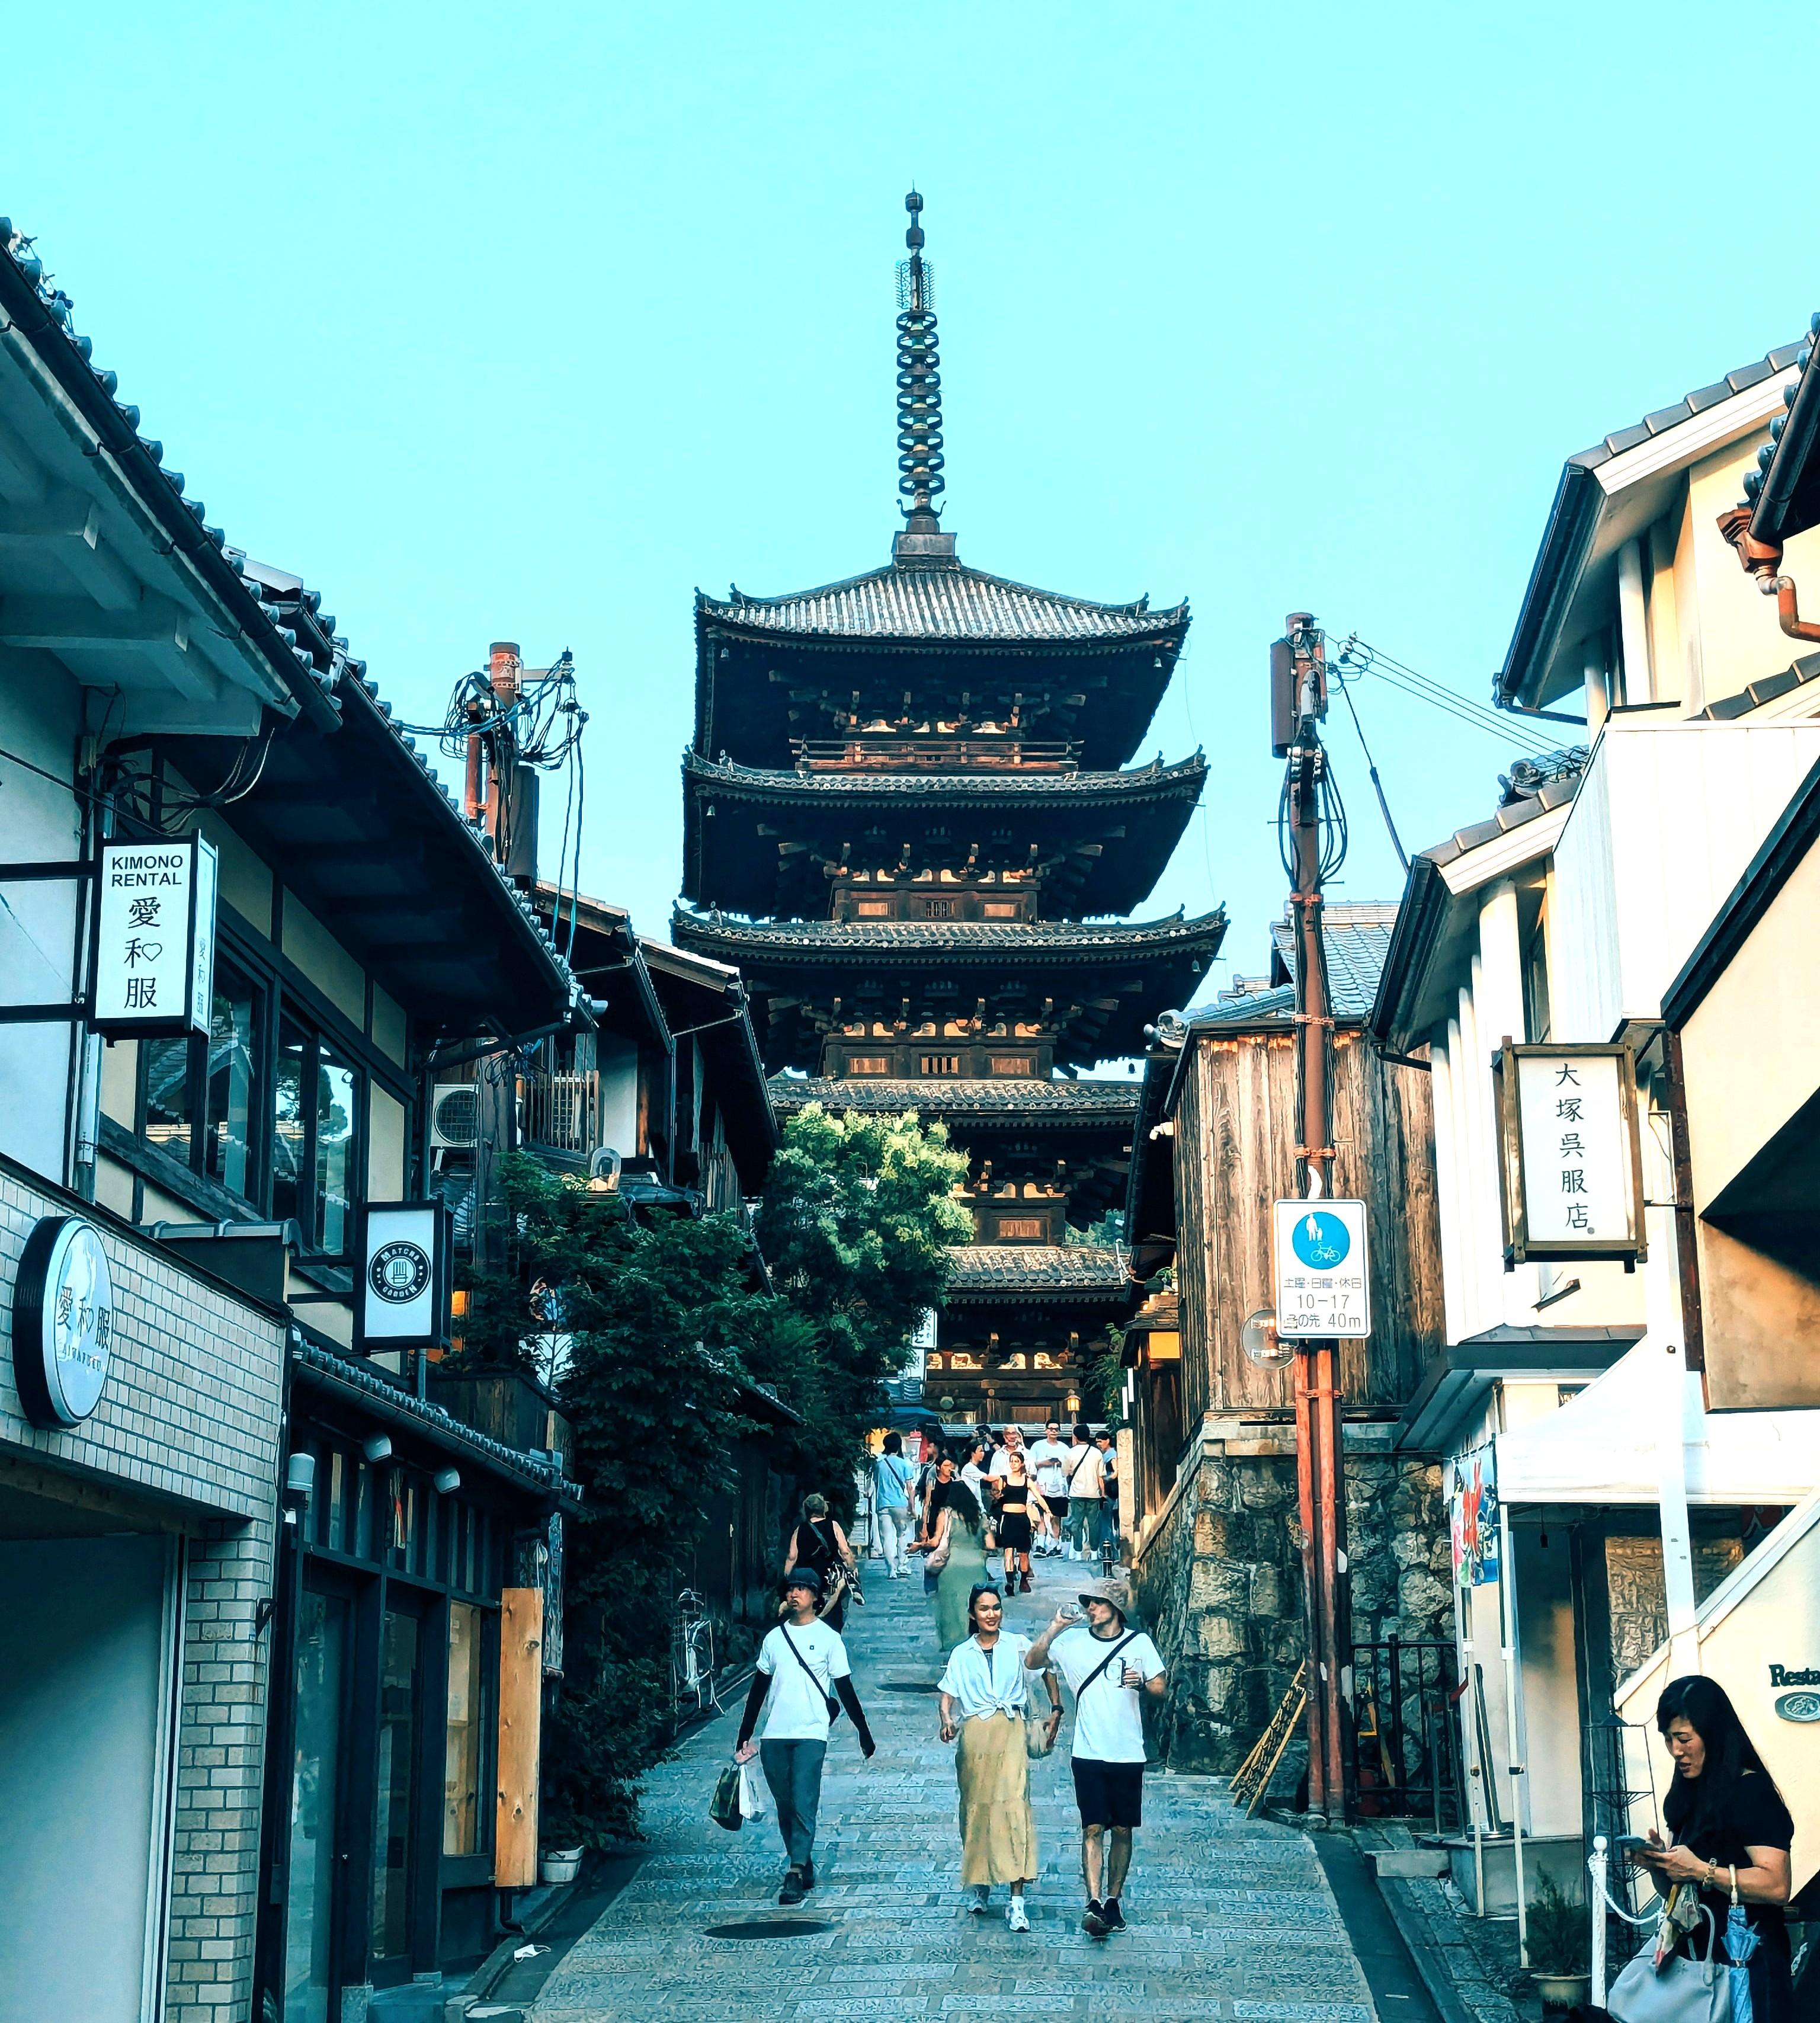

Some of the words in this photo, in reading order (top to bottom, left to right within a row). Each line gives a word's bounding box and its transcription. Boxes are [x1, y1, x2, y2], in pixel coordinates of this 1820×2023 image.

[112, 855, 183, 870] KIMONO
[111, 872, 182, 887] RENTAL
[124, 897, 162, 1009] 愛和服
[1555, 1062, 1588, 1228] 大塚呉服店
[380, 1247, 420, 1262] MATCHA
[382, 1284, 418, 1297] GARDEN
